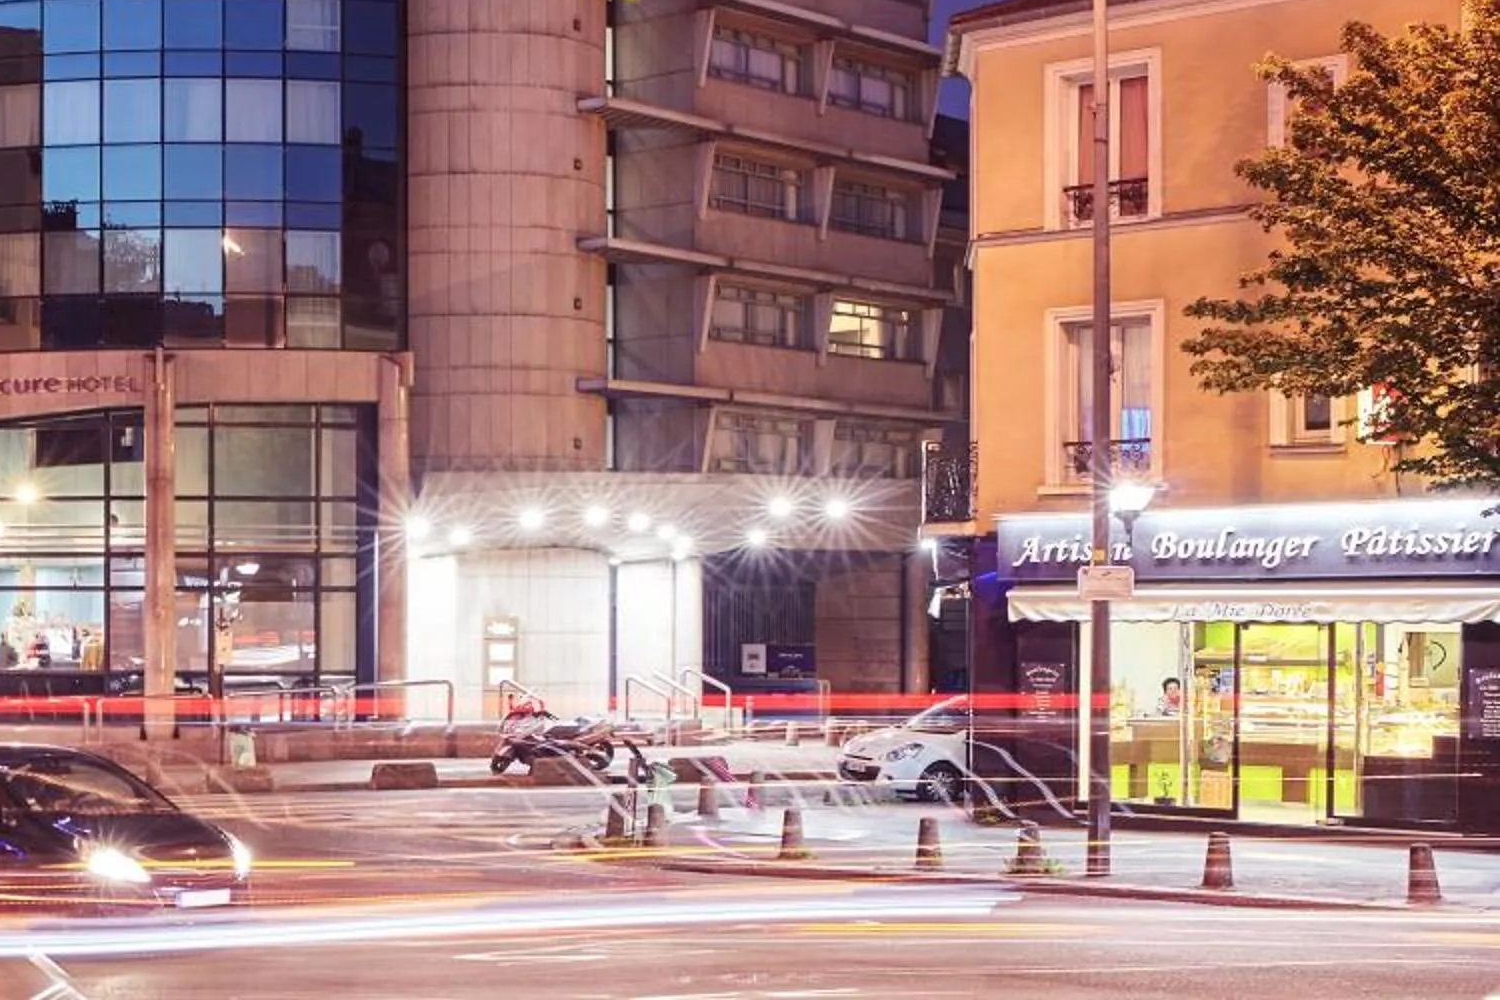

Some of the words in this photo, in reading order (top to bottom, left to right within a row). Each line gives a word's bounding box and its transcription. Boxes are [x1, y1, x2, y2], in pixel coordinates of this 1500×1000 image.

[67, 375, 142, 393] HOTEL
[1012, 534, 1134, 567] Artisn
[1151, 525, 1323, 569] Boulanger
